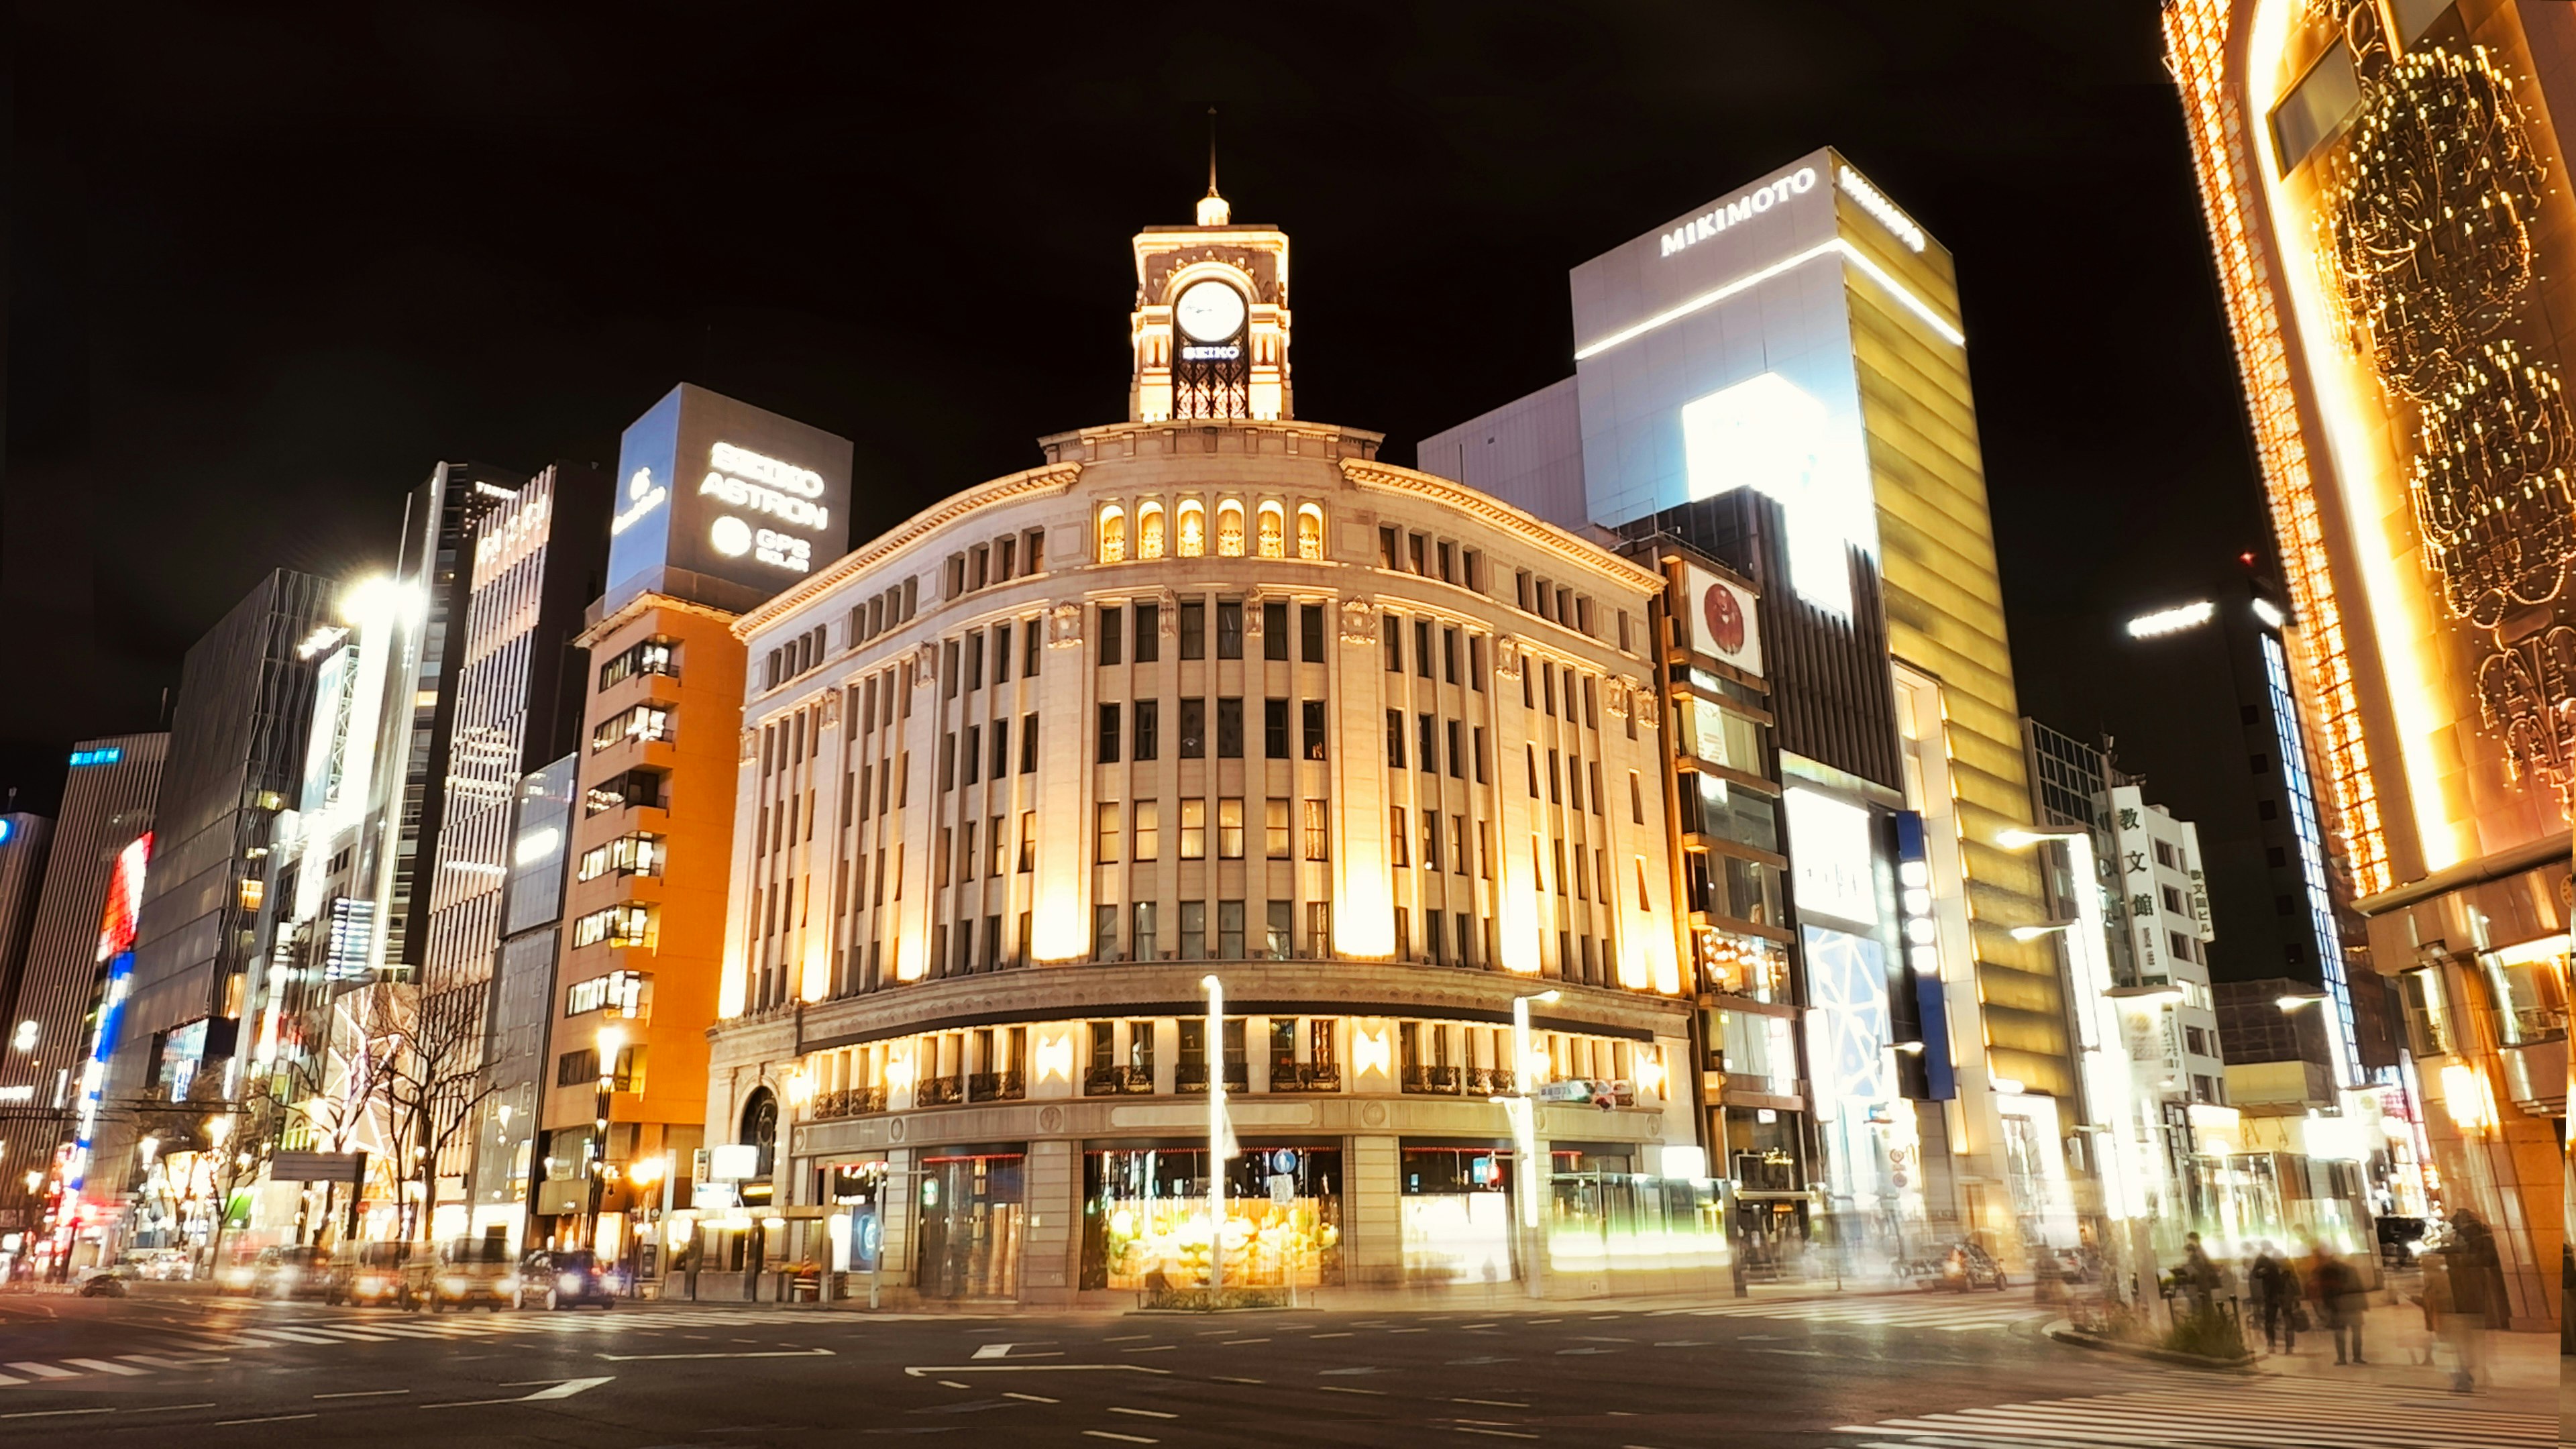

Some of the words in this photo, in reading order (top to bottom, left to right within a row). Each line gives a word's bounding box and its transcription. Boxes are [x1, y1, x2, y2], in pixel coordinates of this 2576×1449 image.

[1660, 168, 1815, 257] MIKIMOTO
[1183, 346, 1239, 360] SEIKO
[711, 442, 824, 498] SEIKO
[699, 472, 828, 530] ASTRON
[756, 529, 810, 559] GPS
[2119, 808, 2153, 916] 教文館
[2190, 870, 2210, 932] 教文館ビル
